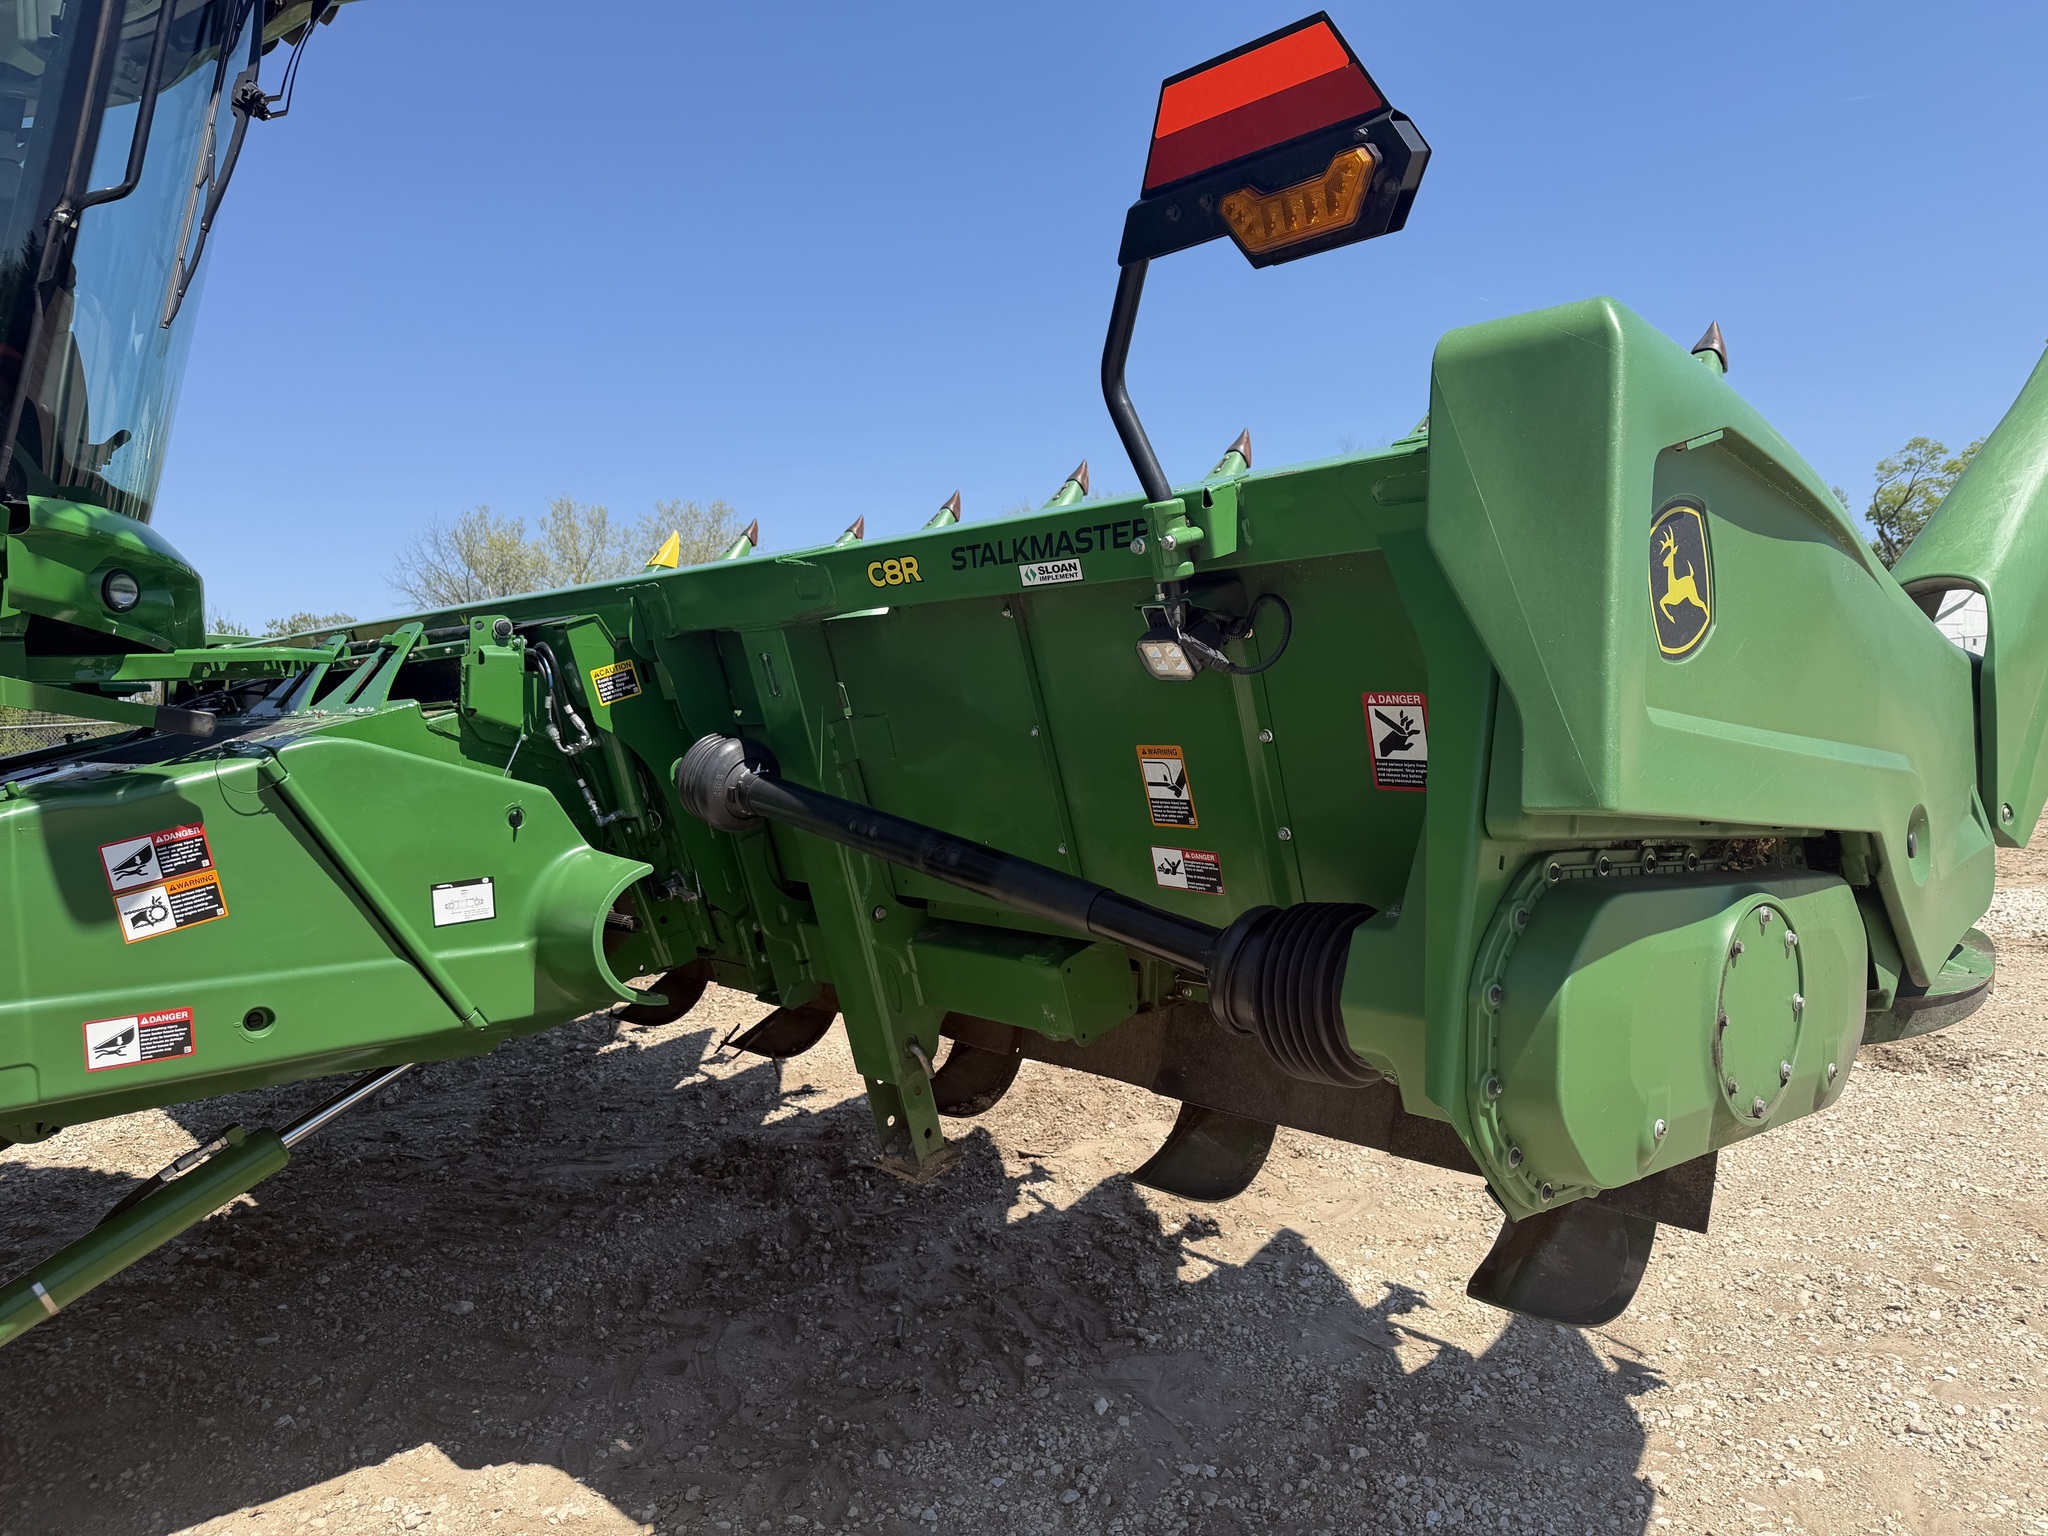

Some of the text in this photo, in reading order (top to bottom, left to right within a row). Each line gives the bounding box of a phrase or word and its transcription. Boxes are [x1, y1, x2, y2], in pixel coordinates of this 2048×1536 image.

[867, 555, 924, 588] C8R
[1037, 562, 1078, 576] SLOAN
[1039, 572, 1079, 582] IMPLEMENT
[600, 661, 632, 677] CAUTION
[1378, 695, 1420, 704] DANGER
[163, 827, 200, 842] DANGER
[176, 875, 214, 889] WARNING
[149, 1011, 188, 1023] DANGER
